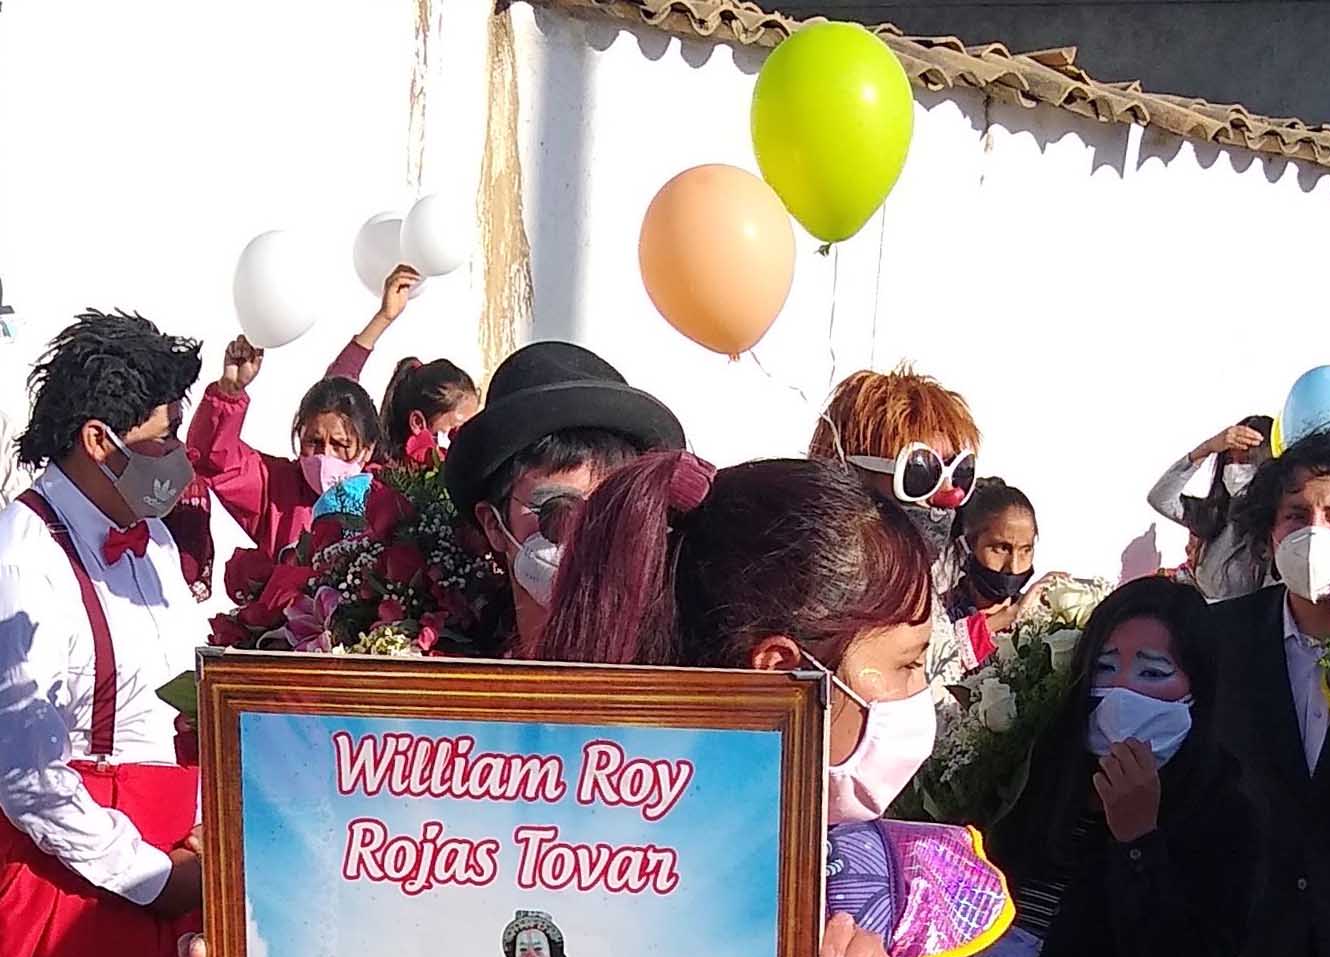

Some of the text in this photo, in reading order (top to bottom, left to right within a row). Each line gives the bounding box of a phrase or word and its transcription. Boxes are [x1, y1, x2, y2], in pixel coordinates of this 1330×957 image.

[334, 732, 694, 821] William Roy
[343, 818, 680, 896] Rojas Tovar
